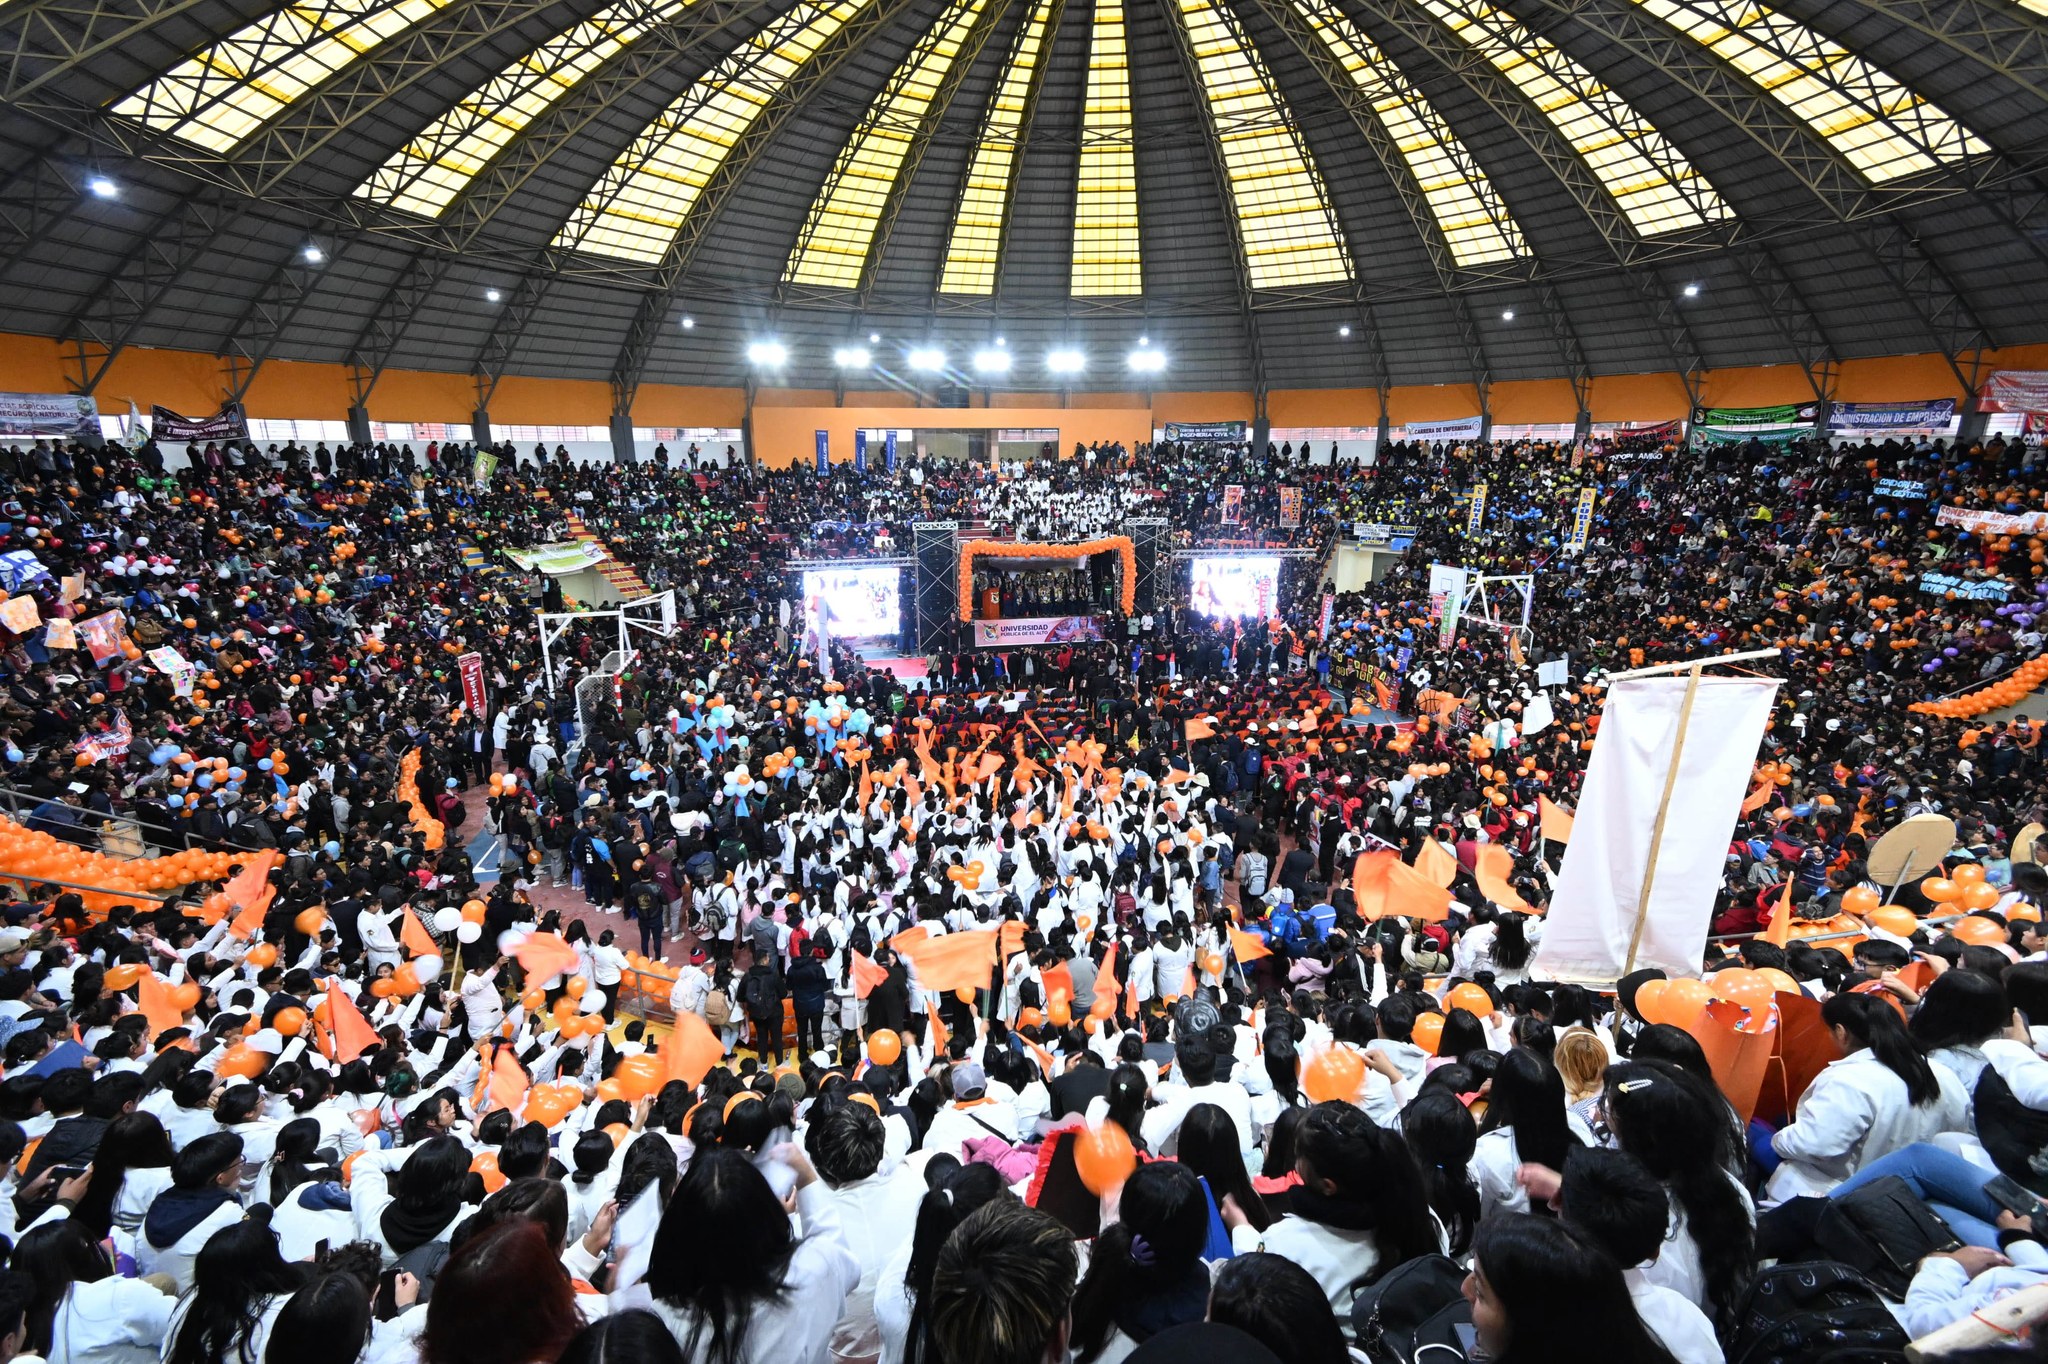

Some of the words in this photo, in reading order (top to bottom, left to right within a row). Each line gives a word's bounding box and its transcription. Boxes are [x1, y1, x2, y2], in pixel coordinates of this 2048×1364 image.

[1893, 412, 1905, 423] DE
[1906, 410, 1952, 422] EMPRESAS
[1638, 452, 1663, 460] AMIGO
[1000, 624, 1048, 632] UNIVERSIDAD
